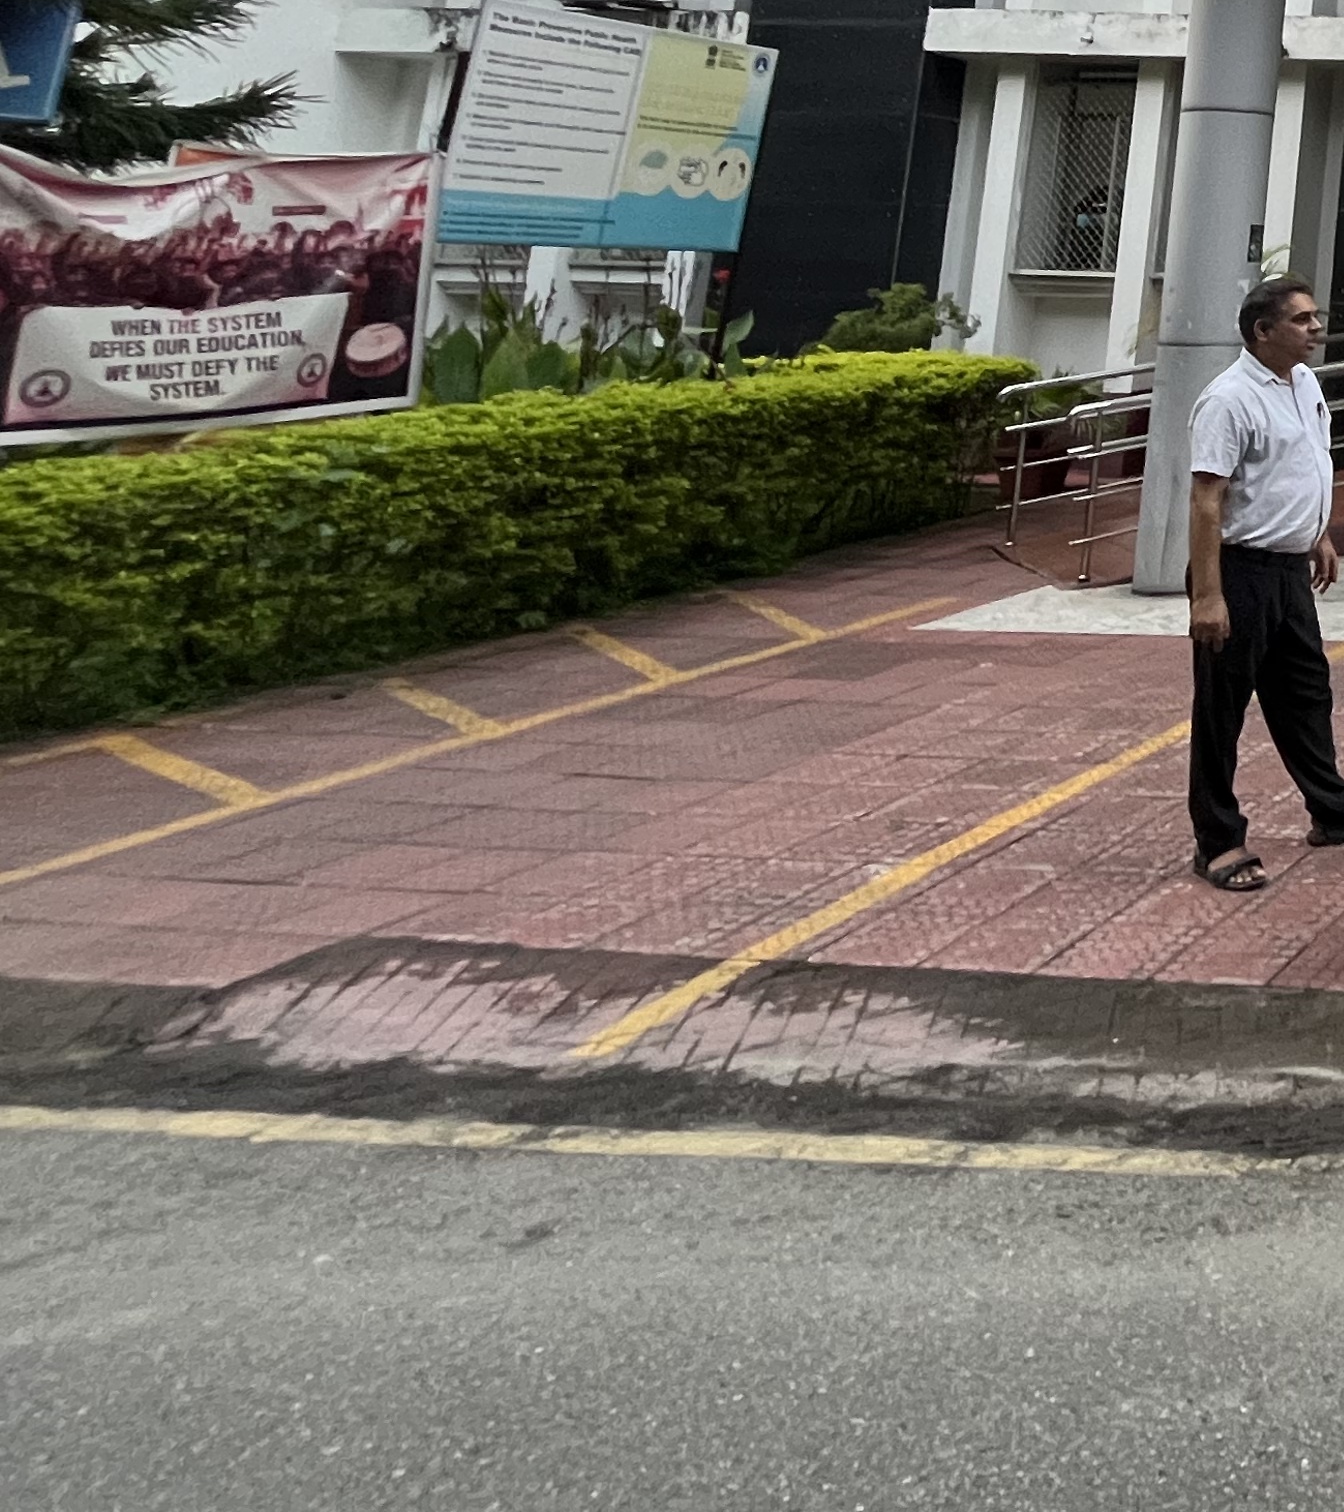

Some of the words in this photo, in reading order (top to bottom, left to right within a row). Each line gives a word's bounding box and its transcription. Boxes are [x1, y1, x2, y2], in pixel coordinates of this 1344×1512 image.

[111, 319, 161, 337] WHEN
[168, 318, 201, 334] THE
[207, 311, 282, 333] SYSTEM
[89, 340, 145, 359] DEFIES
[153, 338, 191, 356] OUR
[105, 364, 131, 382] WE
[136, 361, 184, 380] MUST
[192, 358, 240, 378] DEFY
[246, 354, 280, 372] THE
